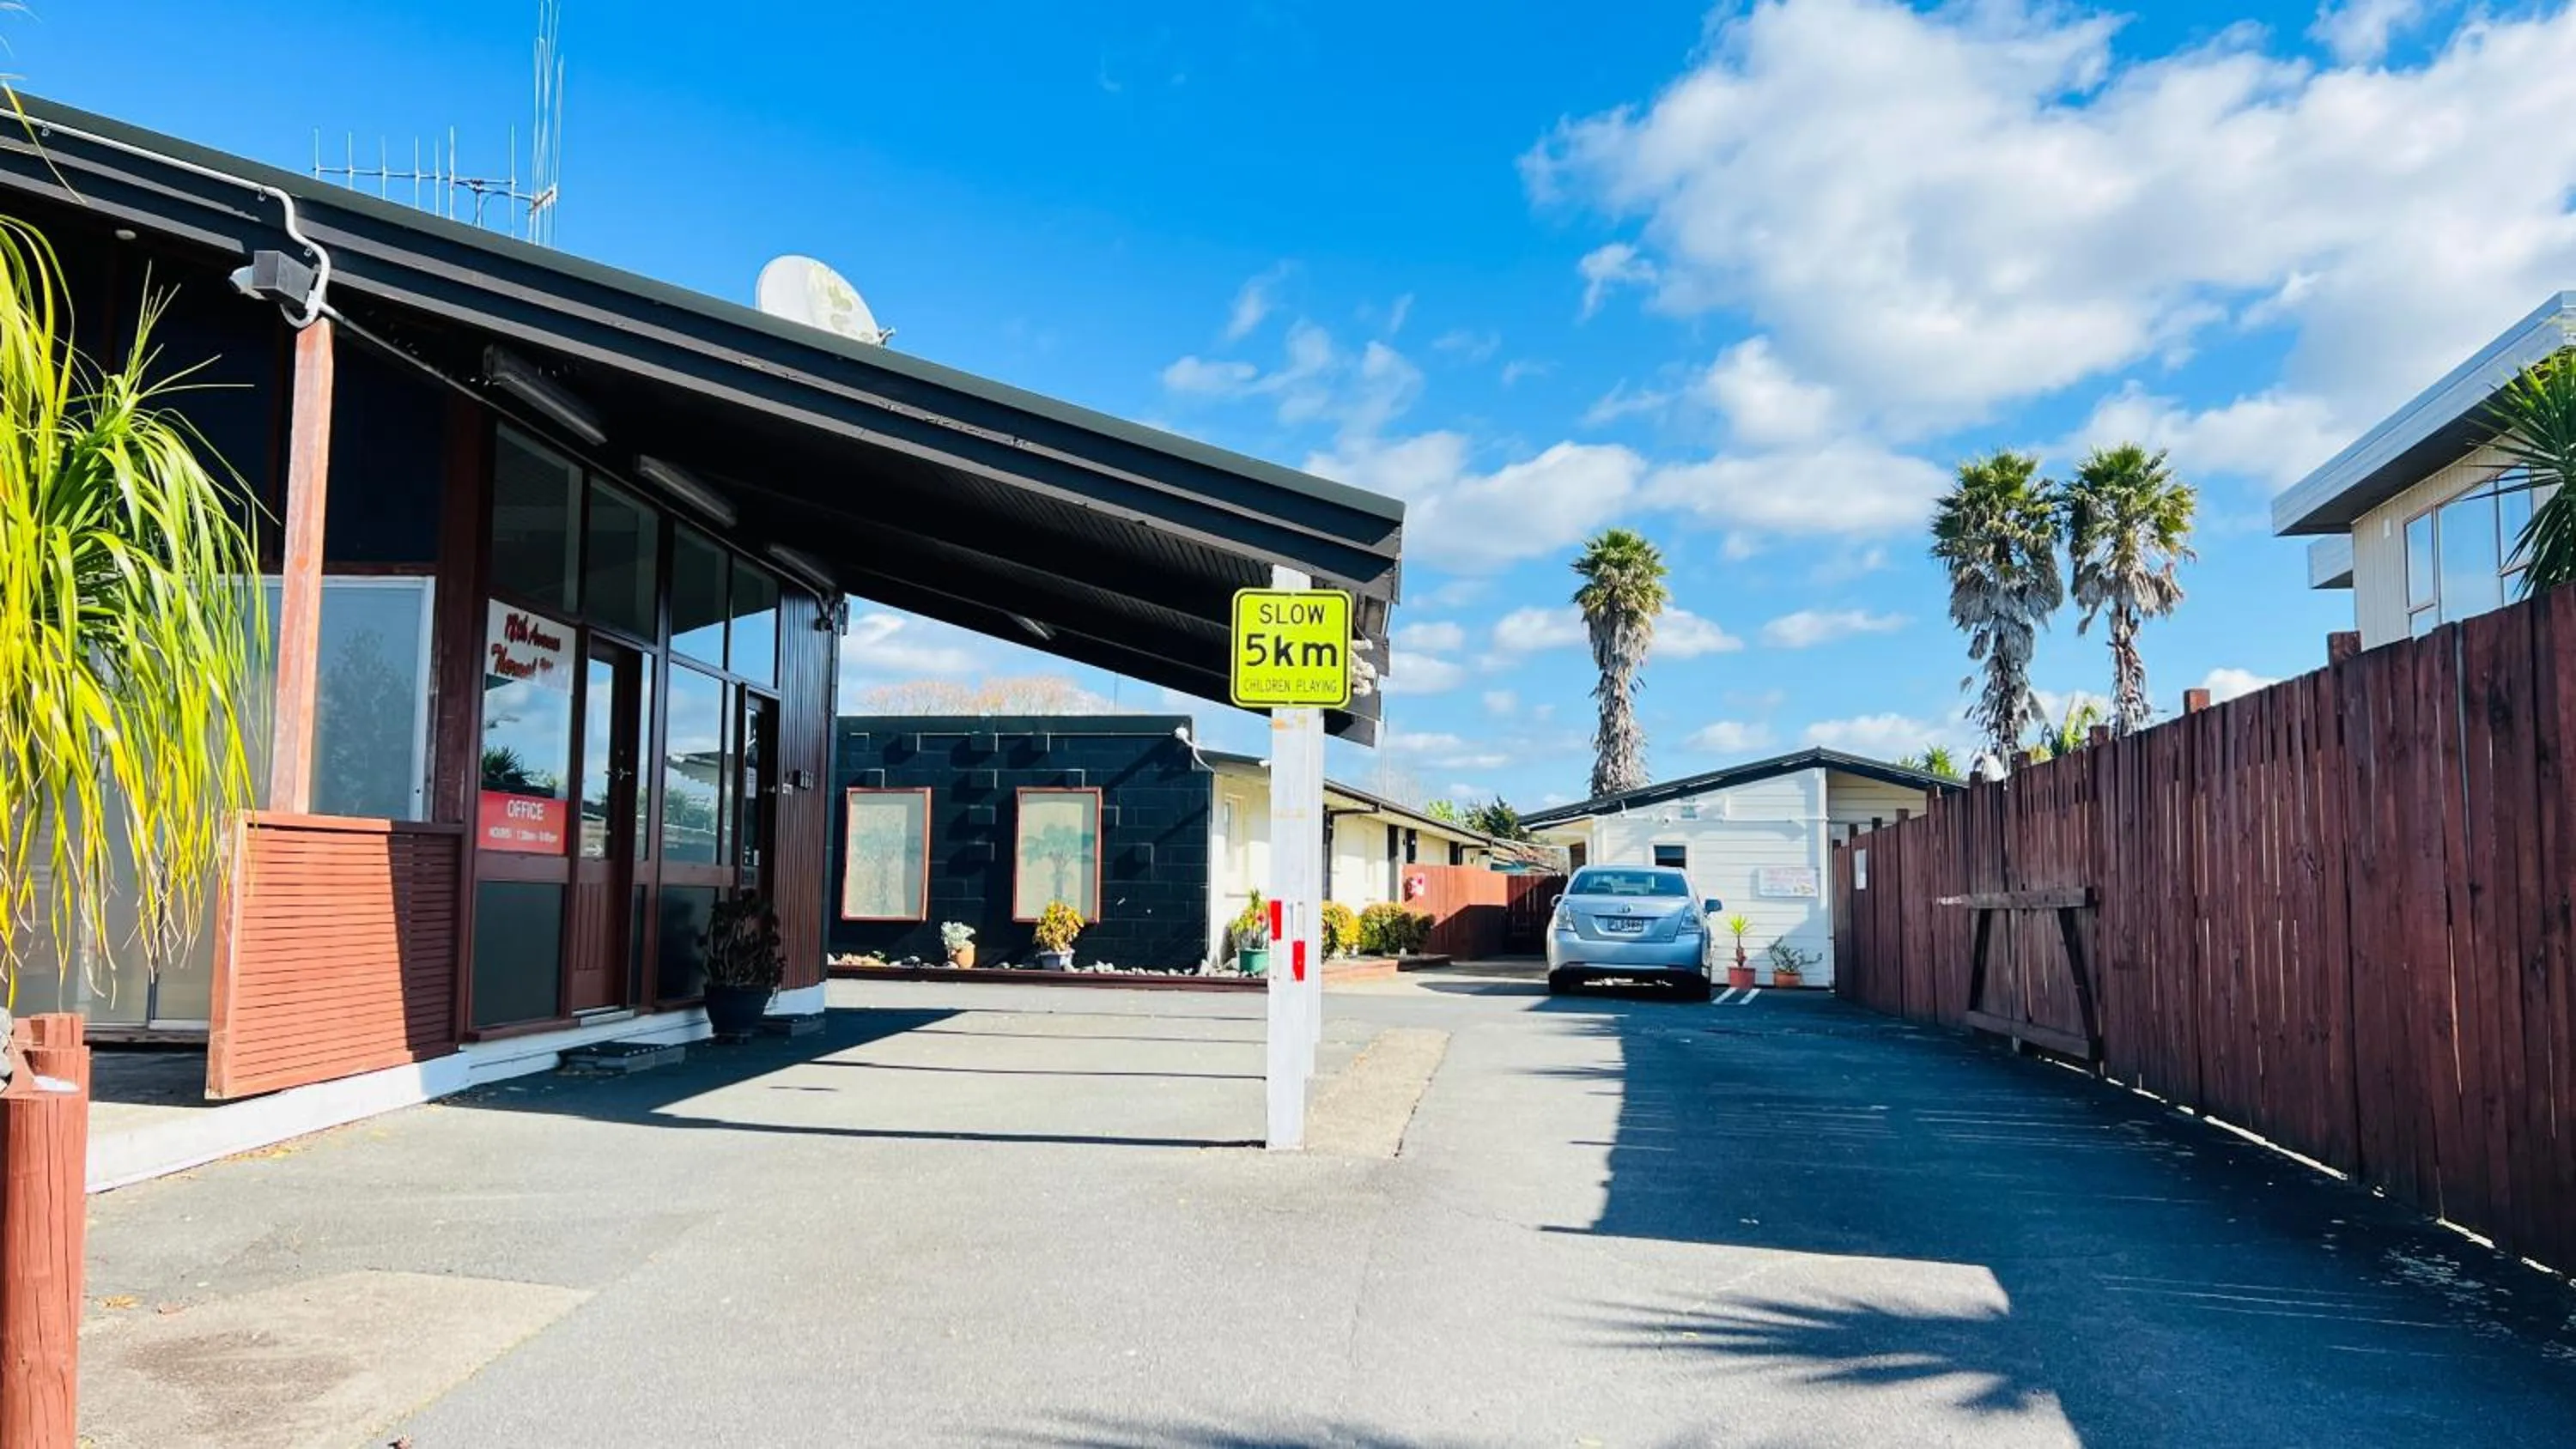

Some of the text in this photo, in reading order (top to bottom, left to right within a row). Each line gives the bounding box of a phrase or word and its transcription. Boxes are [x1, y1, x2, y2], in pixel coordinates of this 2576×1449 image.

[1259, 603, 1326, 625] SLOW
[1245, 633, 1337, 667] 5km
[1244, 677, 1337, 694] CHILDREN PLAYING
[507, 799, 544, 822] OFFICE
